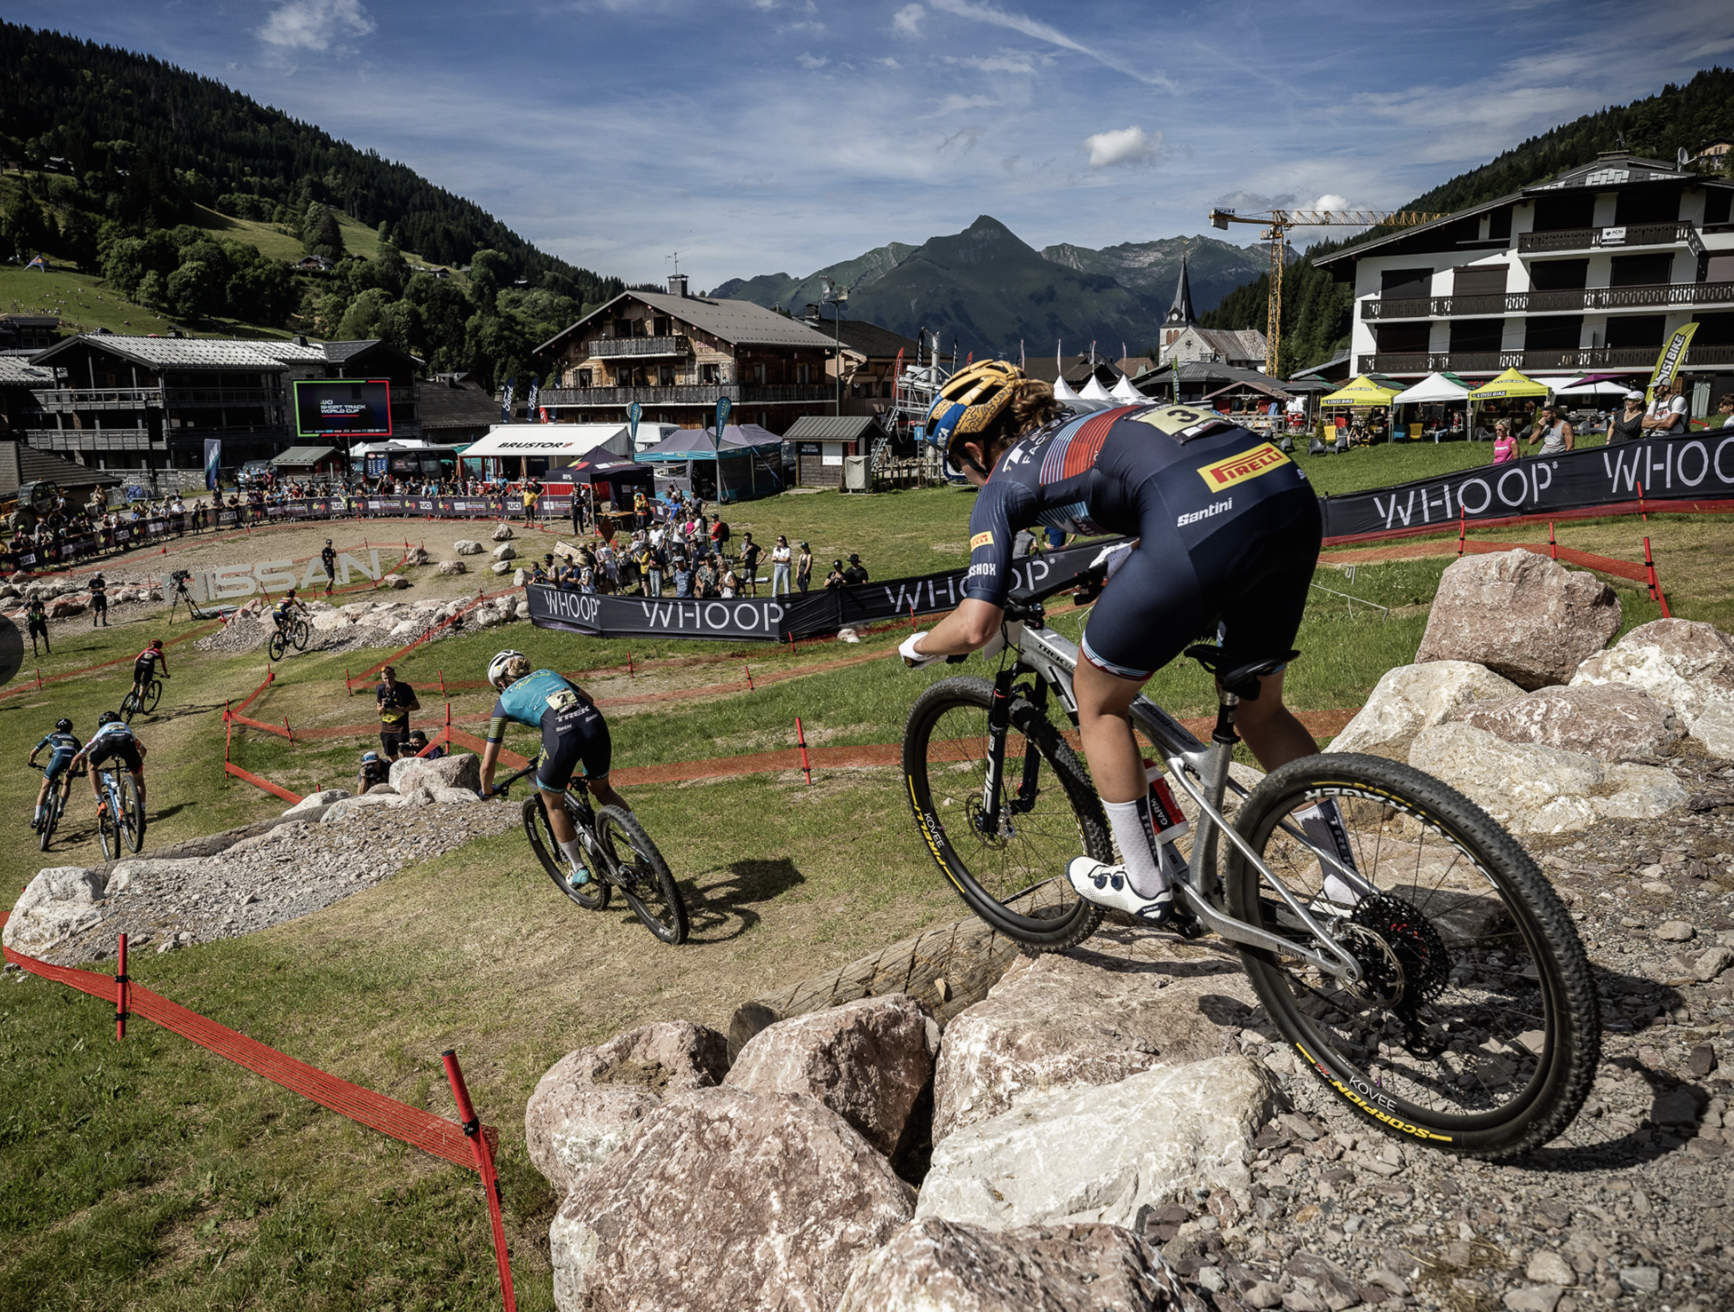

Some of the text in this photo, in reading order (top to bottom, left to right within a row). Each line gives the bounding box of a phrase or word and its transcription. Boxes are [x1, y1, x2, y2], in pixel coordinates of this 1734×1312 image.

[1666, 334, 1686, 359] BIKE
[502, 385, 514, 411] Ford
[528, 385, 539, 411] Ford
[1167, 409, 1200, 423] 3
[498, 441, 564, 449] BRUSTOR
[1210, 447, 1284, 484] PIRELLI
[1374, 462, 1551, 529] WHOOP
[1177, 497, 1233, 527] Santini
[160, 549, 382, 605] NISSAN
[543, 590, 599, 623] WHOOP
[641, 601, 784, 631] WHOOP
[555, 705, 591, 722] TREK
[924, 812, 945, 848] KOVEE
[1350, 1075, 1397, 1113] KOVEE
[1332, 1080, 1430, 1139] SCORPION
